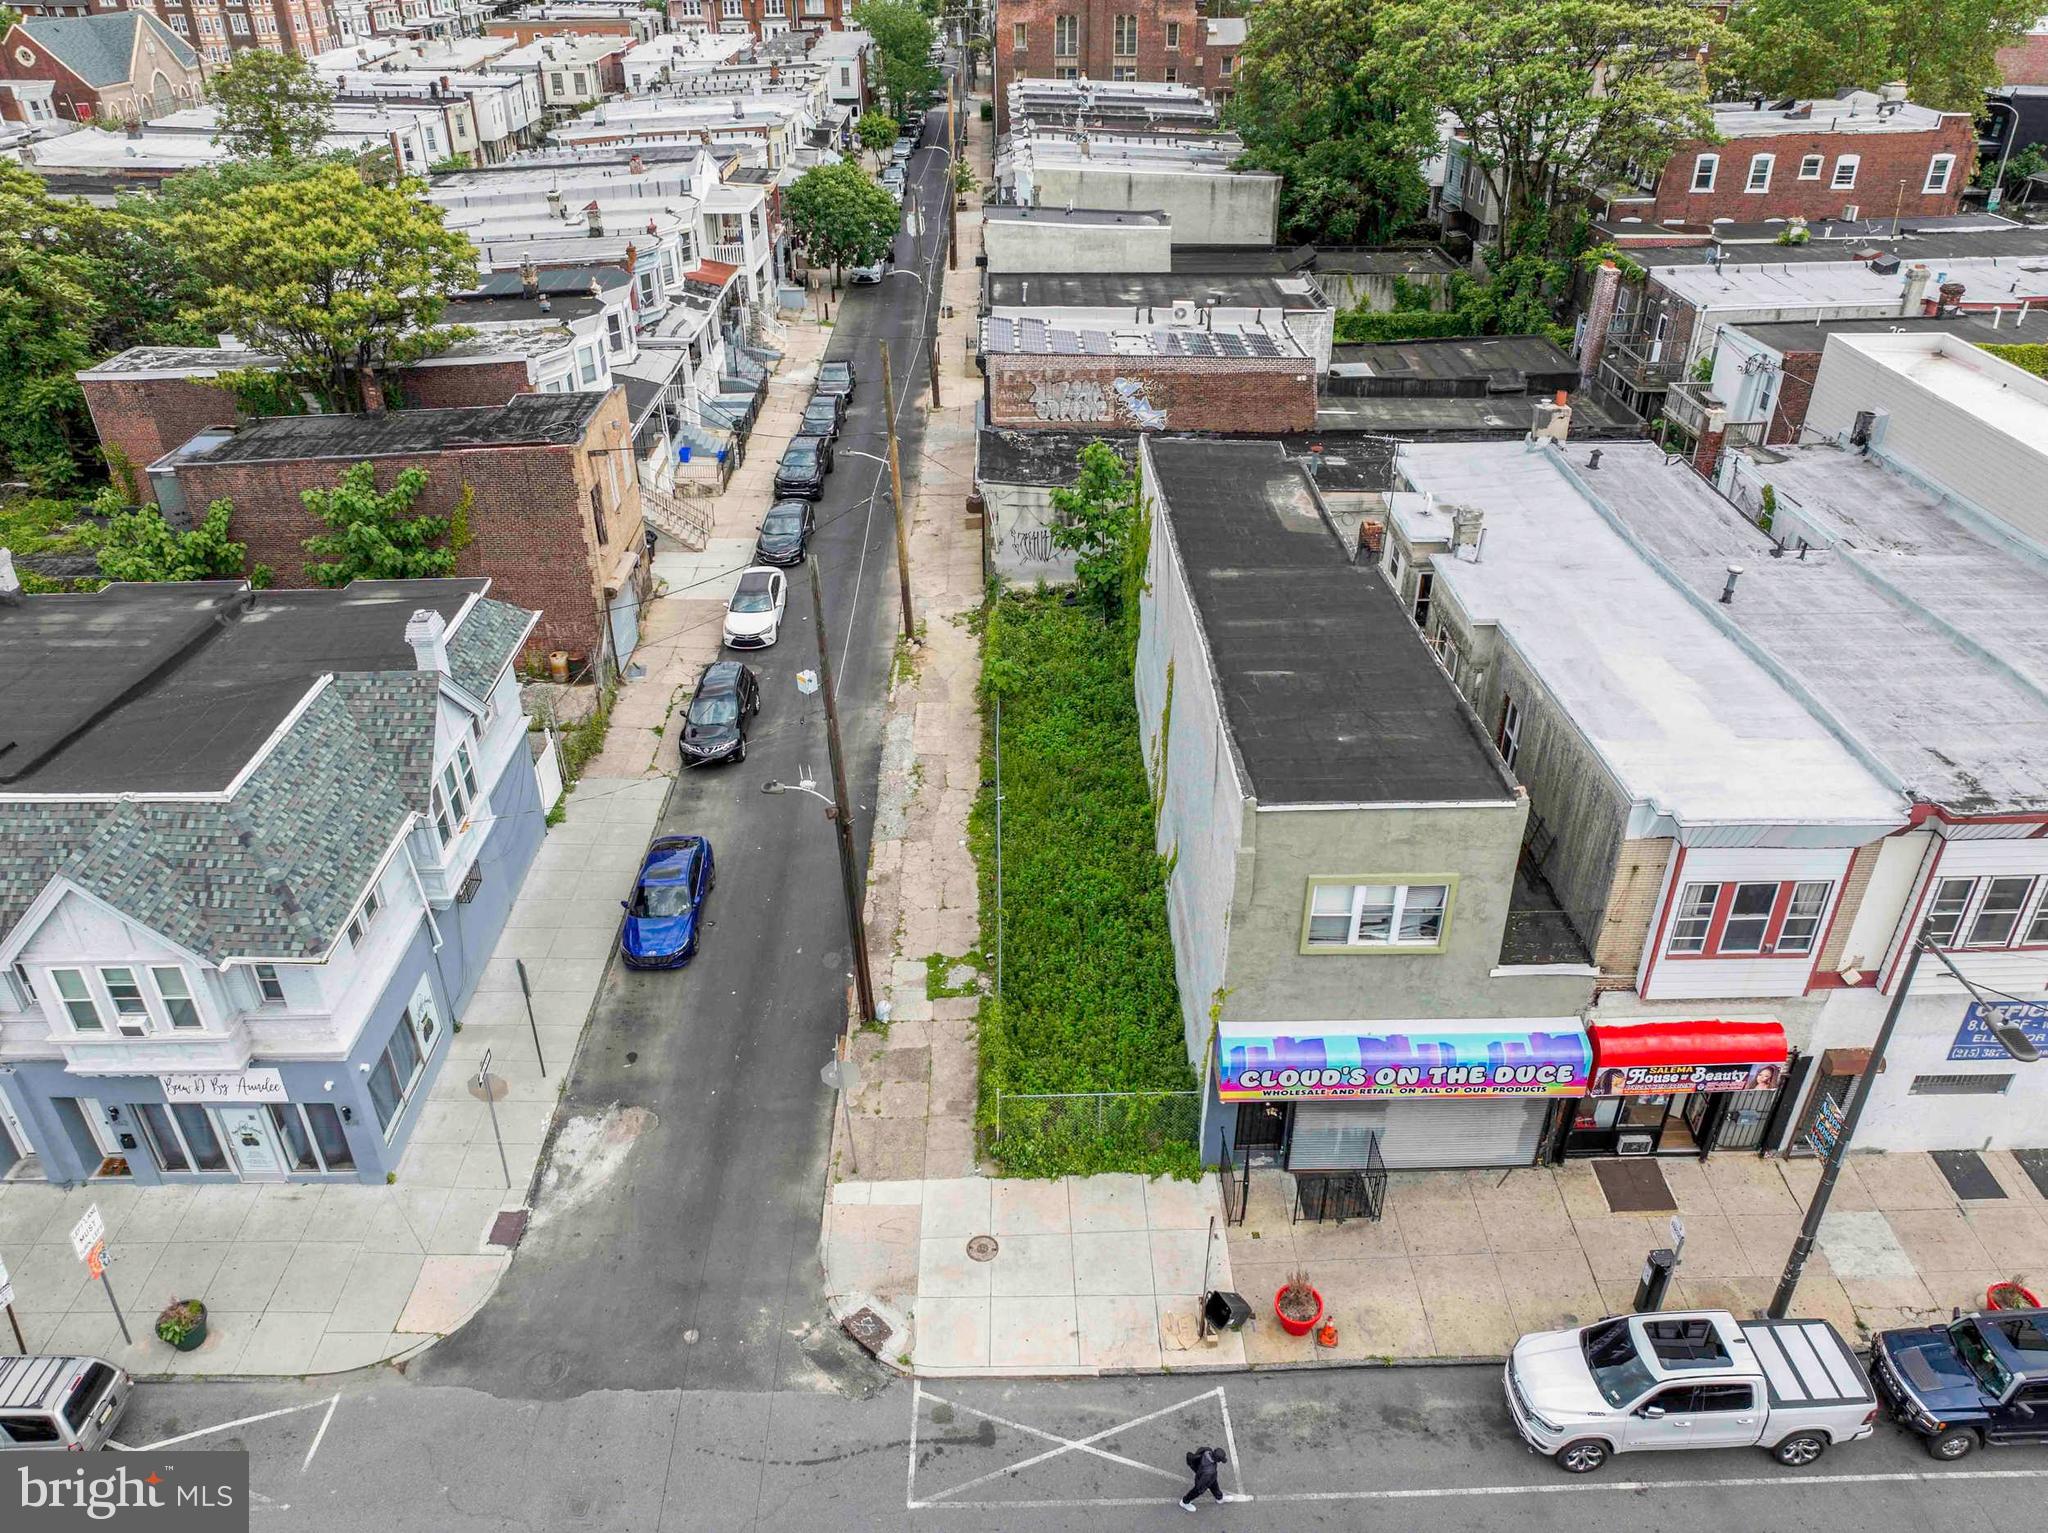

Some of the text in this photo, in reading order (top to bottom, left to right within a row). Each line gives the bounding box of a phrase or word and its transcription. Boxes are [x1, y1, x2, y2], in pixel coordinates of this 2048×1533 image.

[1952, 1048, 1980, 1059] (215)
[1239, 1064, 1574, 1088] CLOUD'S ON THE DUCE
[1626, 1068, 1680, 1085] House
[1690, 1066, 1749, 1083] Beauty
[1649, 1066, 1694, 1074] SALEMA
[1262, 1089, 1326, 1097] WHOLESALE
[1399, 1087, 1416, 1095] ON
[1445, 1086, 1460, 1094] OF
[1492, 1085, 1547, 1093] PRODUCTS
